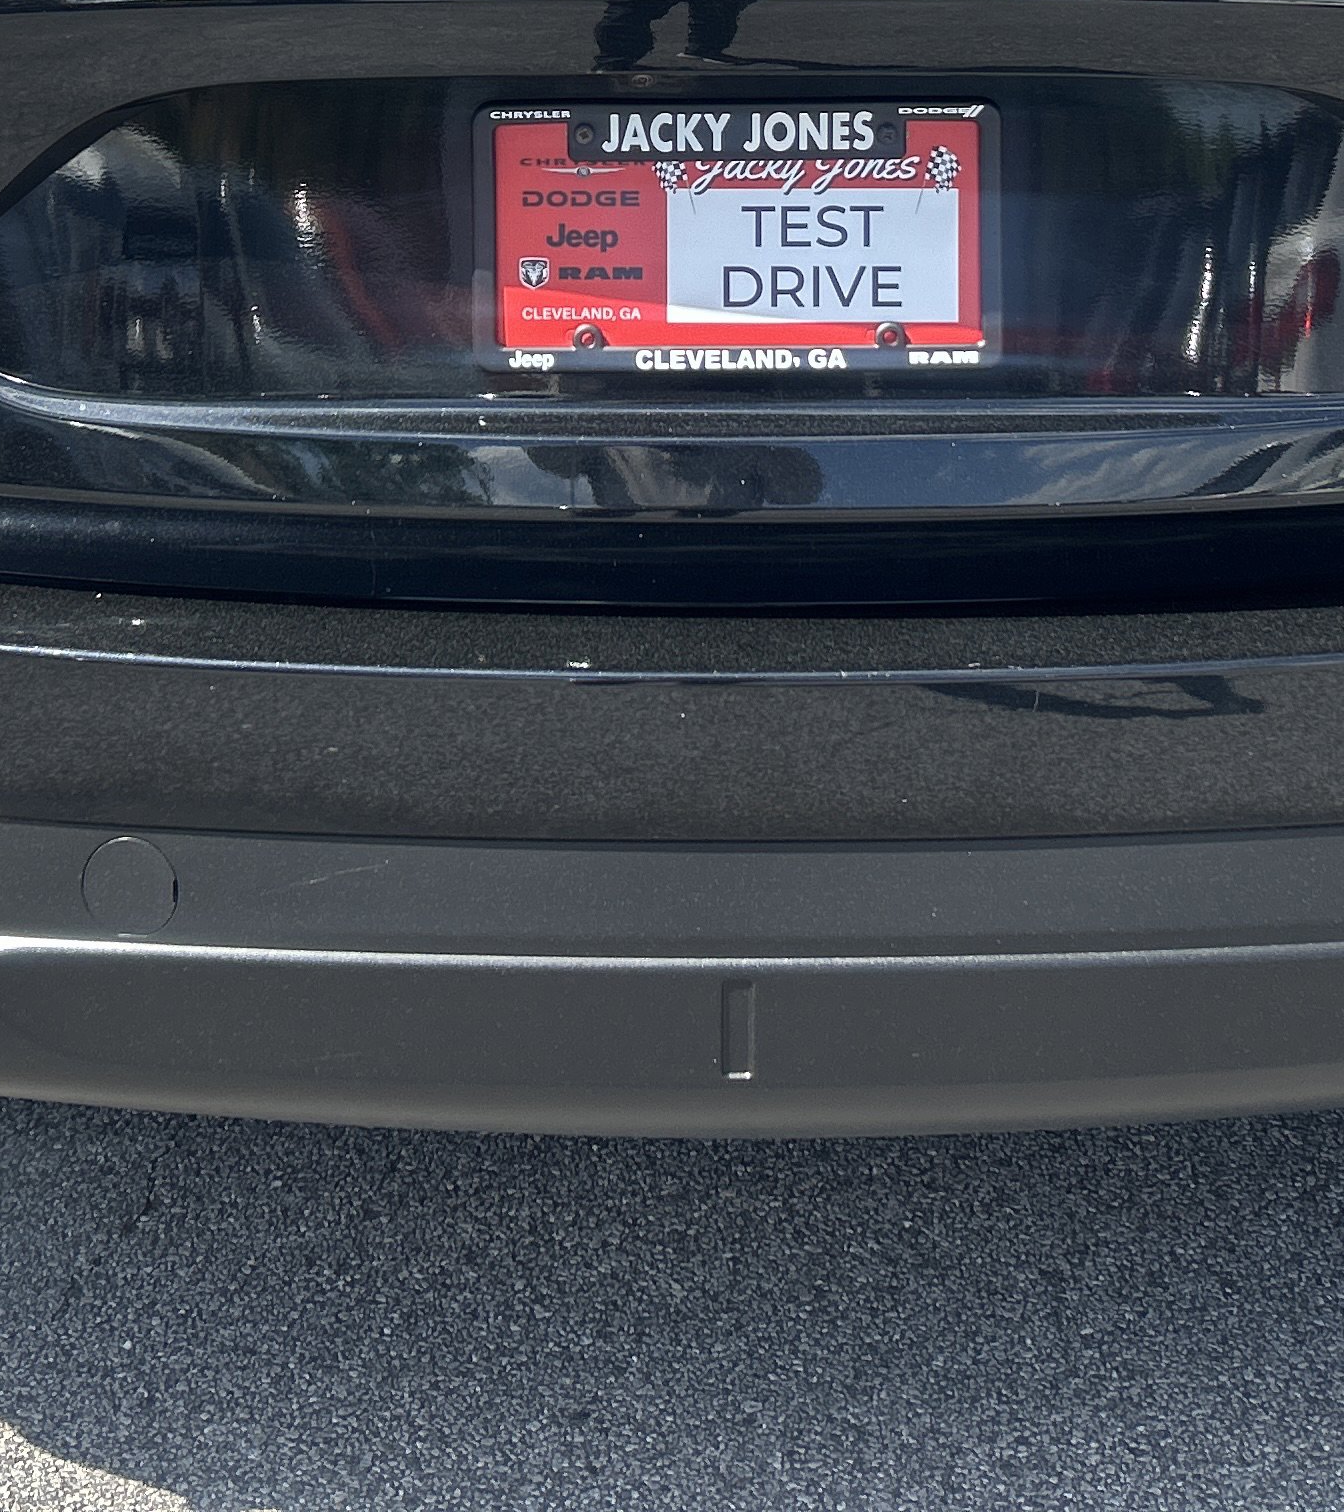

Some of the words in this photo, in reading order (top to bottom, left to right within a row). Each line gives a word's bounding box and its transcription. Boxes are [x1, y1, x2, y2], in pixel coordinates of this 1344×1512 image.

[490, 110, 571, 120] CHRYSLER
[898, 106, 974, 116] DODGE
[601, 112, 731, 153] JACKY
[743, 111, 875, 153] JONES
[810, 156, 921, 195] Jones
[522, 190, 641, 207] DODGE
[741, 205, 884, 248] TEST
[546, 223, 619, 252] Jeep
[558, 266, 644, 281] RAM
[722, 265, 903, 308] DRIVE
[522, 307, 617, 321] CLEVELAND,
[619, 307, 641, 321] GA
[508, 350, 555, 371] Jeep
[635, 349, 801, 370] CLEVELAND,
[808, 349, 847, 370] GA
[908, 350, 979, 365] RAM
